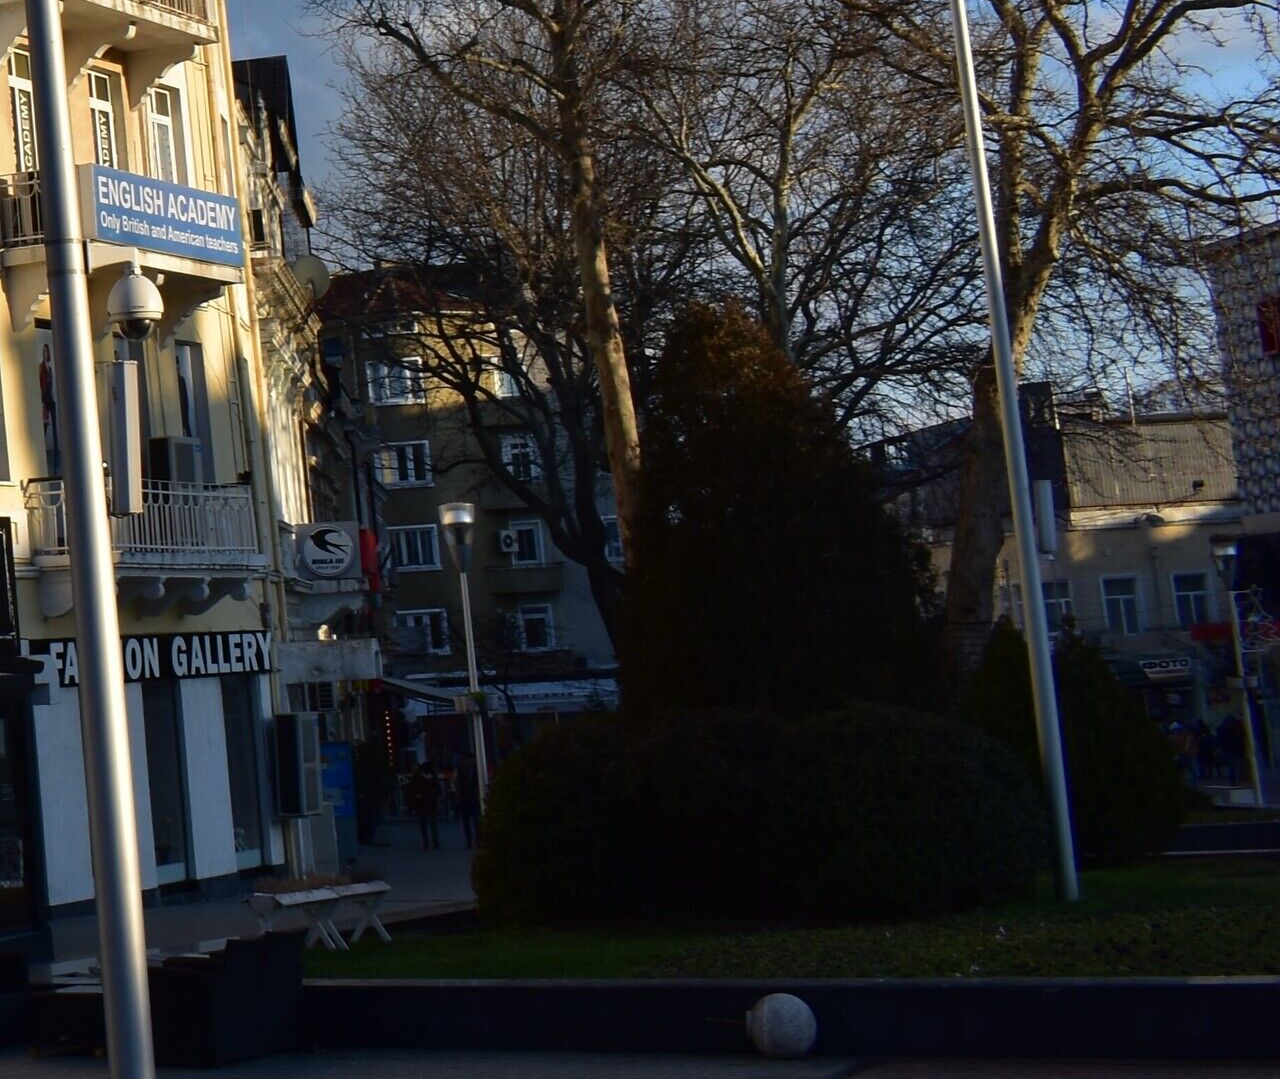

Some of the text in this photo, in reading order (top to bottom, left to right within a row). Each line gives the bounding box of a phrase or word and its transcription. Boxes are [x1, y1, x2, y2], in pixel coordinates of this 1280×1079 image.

[19, 92, 33, 171] CADEMY
[98, 175, 236, 232] ENGLISH ACADEMY
[100, 211, 239, 254] Only British and American teachers
[49, 632, 273, 685] FAON GALLERY
[1142, 658, 1189, 670] ФОТО
